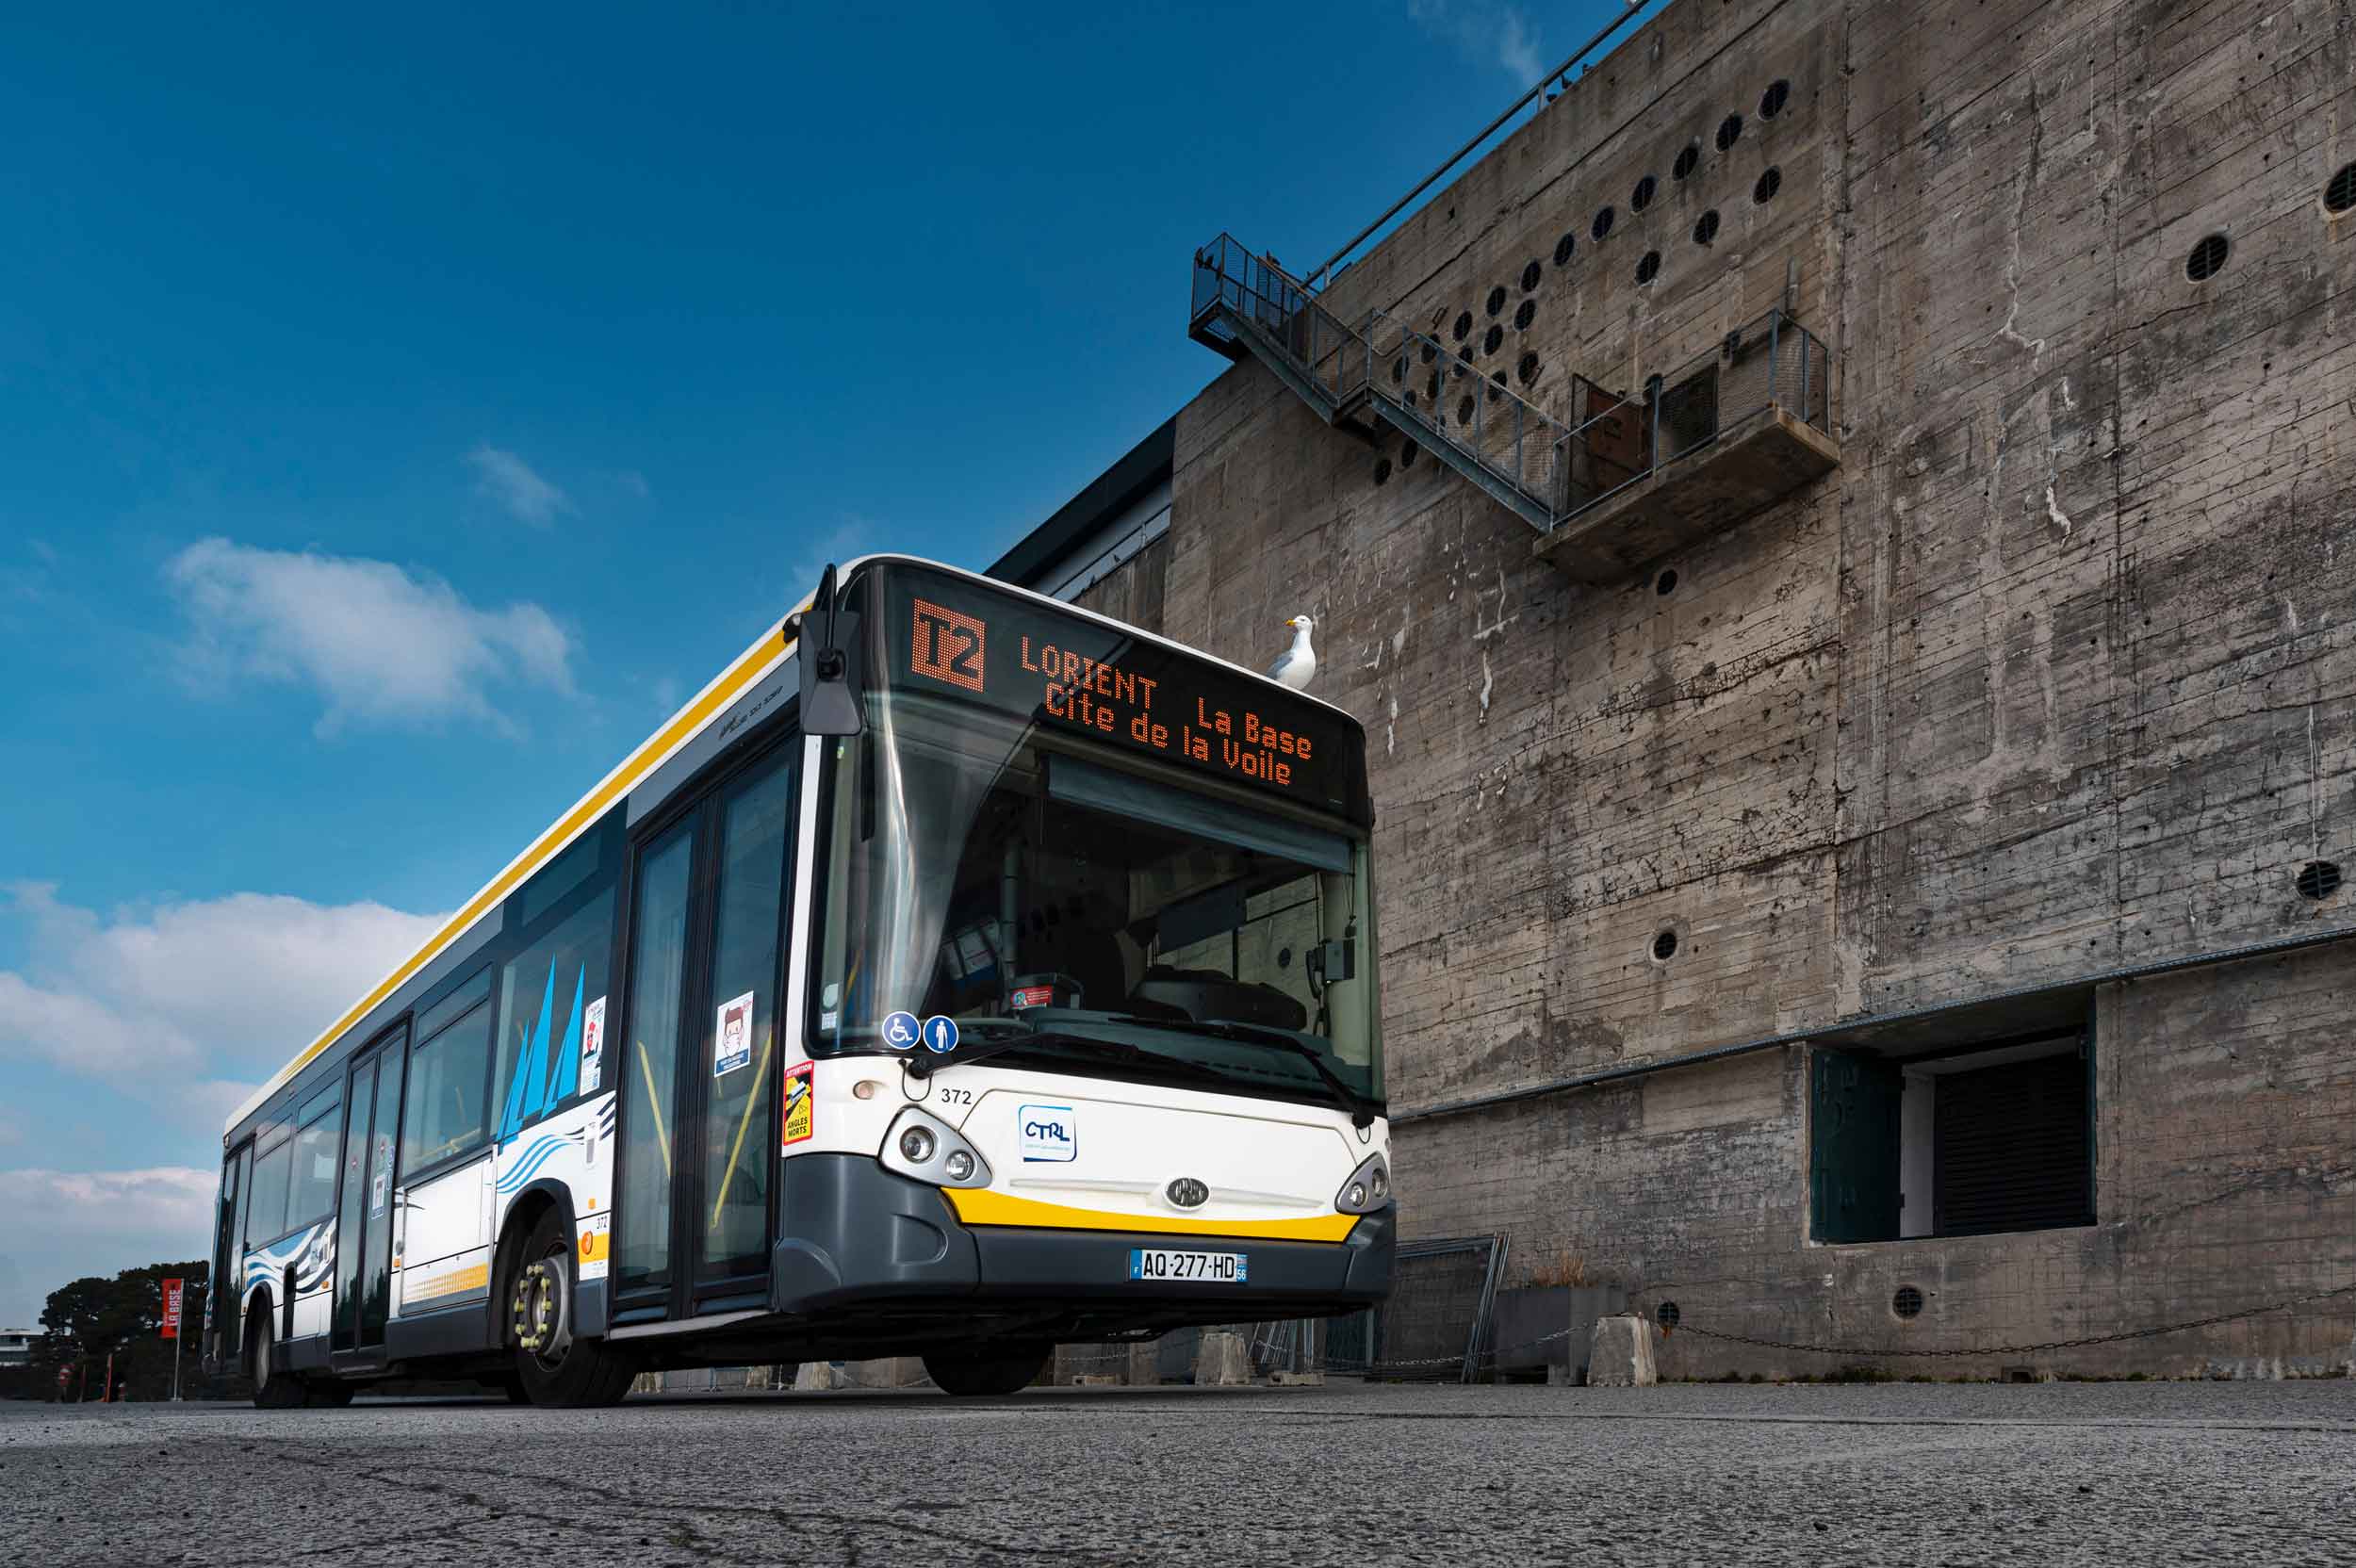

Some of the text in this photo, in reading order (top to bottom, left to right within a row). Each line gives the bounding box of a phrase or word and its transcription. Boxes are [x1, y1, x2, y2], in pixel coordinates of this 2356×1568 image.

[918, 612, 981, 679] T2
[1022, 634, 1313, 760] LORIENT La Base
[1045, 680, 1291, 785] Cite de la Voile
[941, 1088, 972, 1105] 372
[787, 1116, 808, 1130] ANGLES
[788, 1125, 808, 1138] MORTS
[1025, 1120, 1071, 1142] CTRL
[597, 1216, 608, 1230] 372
